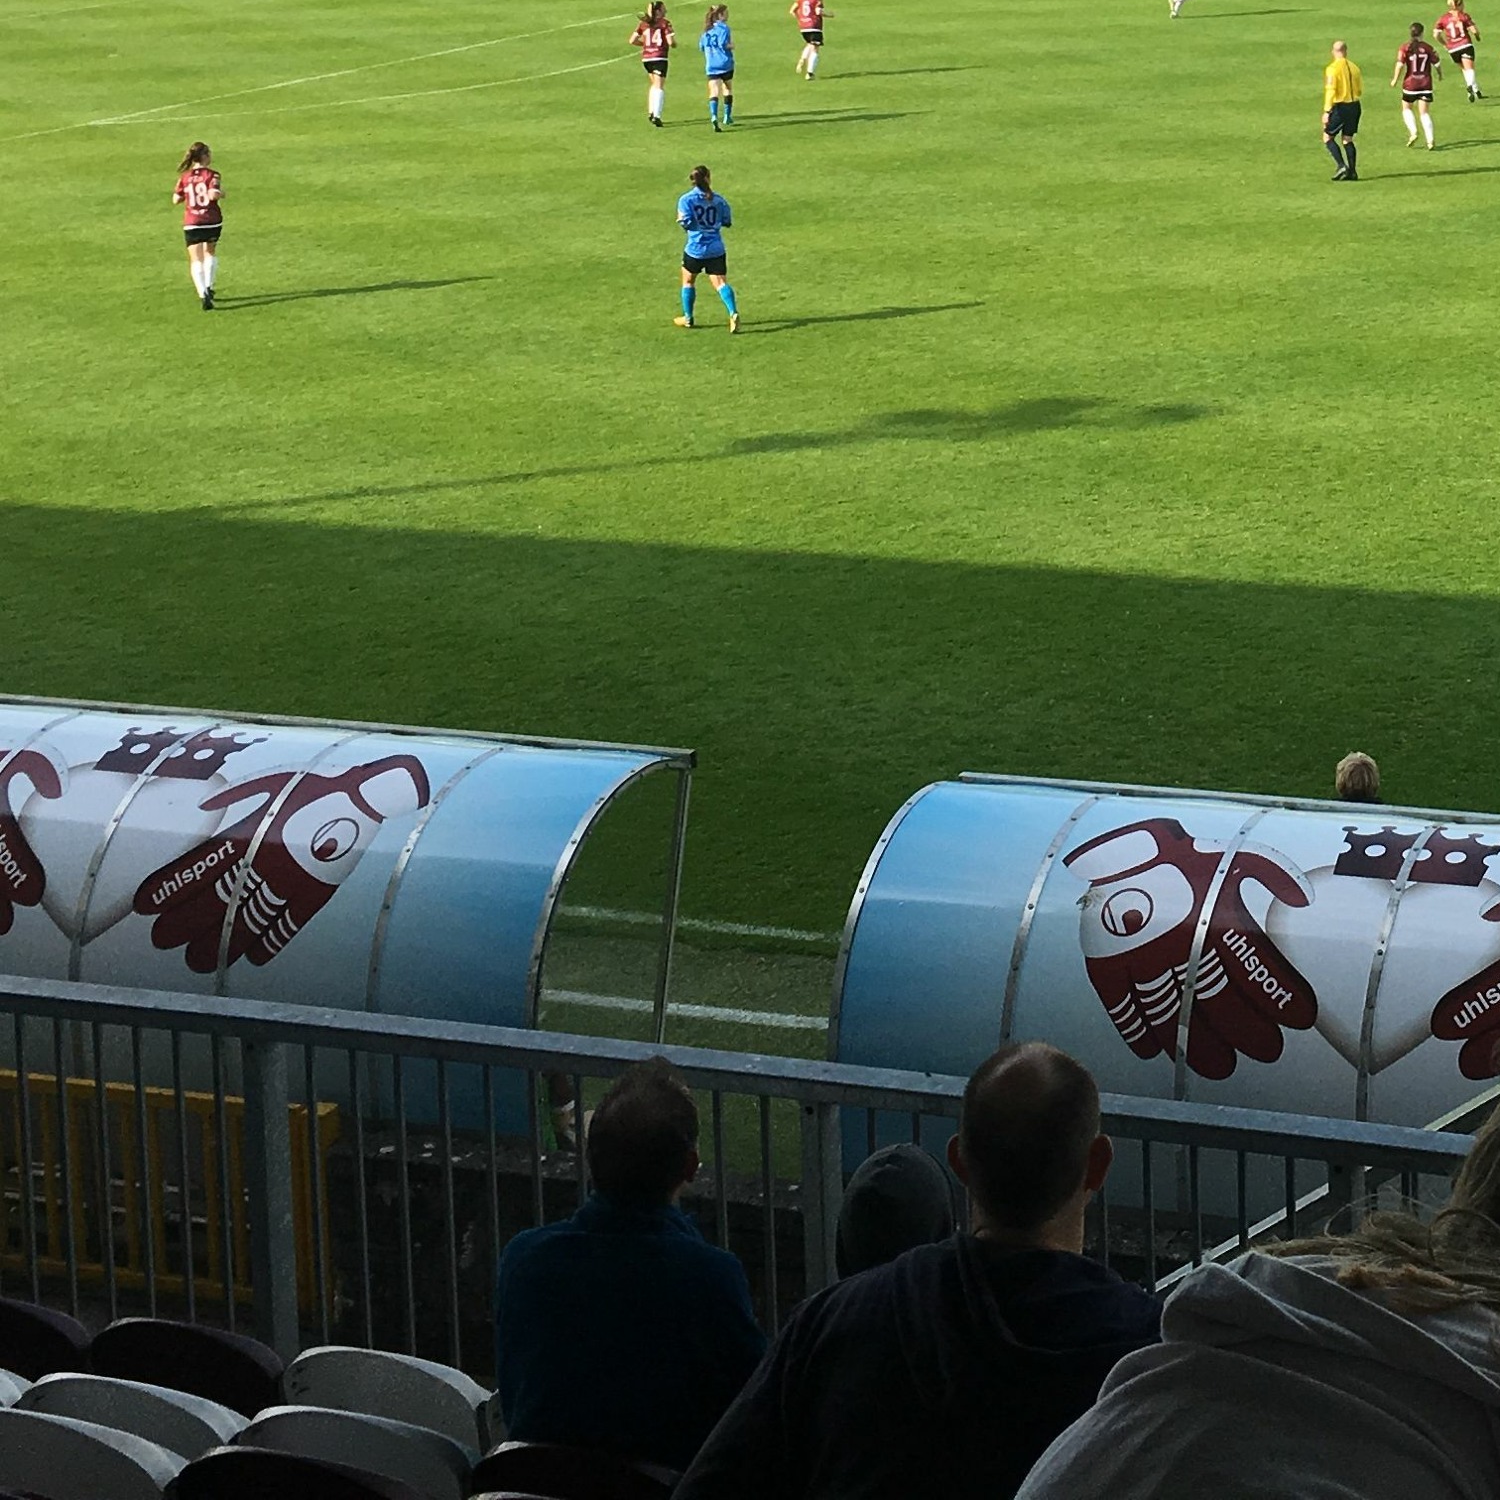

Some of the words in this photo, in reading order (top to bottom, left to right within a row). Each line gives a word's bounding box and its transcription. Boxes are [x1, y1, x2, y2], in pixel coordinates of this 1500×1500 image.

[802, 2, 811, 17] 6
[643, 28, 663, 47] 14
[1446, 21, 1466, 39] 11
[1408, 53, 1428, 73] 17
[183, 181, 210, 207] 18
[694, 205, 717, 226] 20
[152, 840, 235, 905] uhlsport
[1222, 928, 1293, 1010] uhlsport
